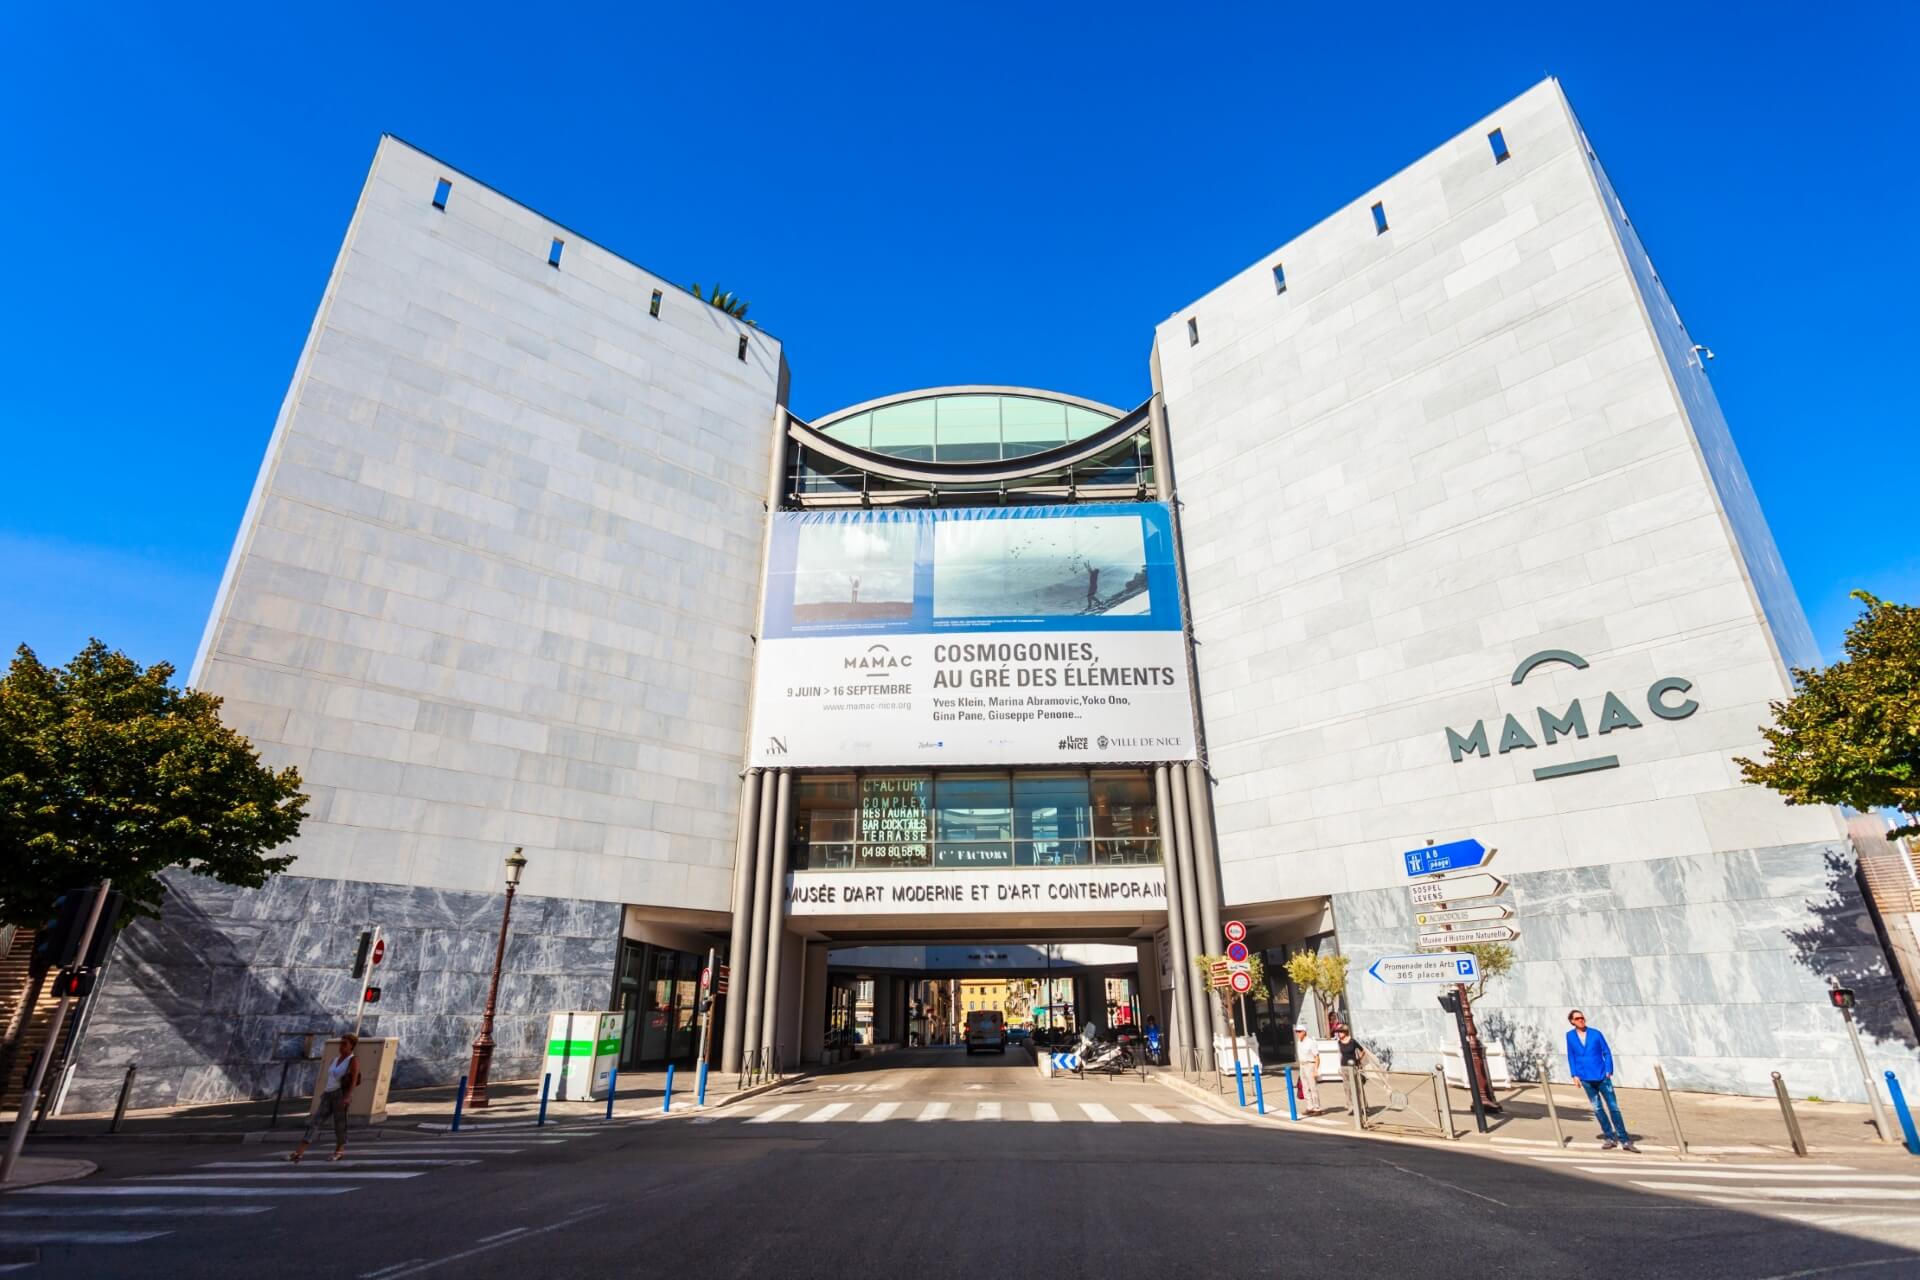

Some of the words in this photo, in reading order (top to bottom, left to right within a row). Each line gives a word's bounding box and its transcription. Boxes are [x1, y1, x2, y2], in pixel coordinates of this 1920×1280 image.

[934, 643, 1099, 663] COSMOGONIES,
[844, 655, 912, 668] MAMAC
[933, 669, 962, 688] AU
[970, 664, 1011, 688] GRÉ
[1017, 668, 1057, 687] DES
[1064, 662, 1175, 687] ÉLÉMENTS
[787, 688, 793, 697] 9
[795, 686, 821, 697] JUIN
[834, 686, 844, 696] 16
[846, 684, 912, 696] SEPTEMBRE
[823, 701, 912, 712] www.mamac-nice.org
[933, 698, 956, 707] Yves
[958, 697, 986, 708] Klein,
[989, 697, 1024, 706] Marina
[1108, 695, 1131, 706] Ono,
[933, 711, 955, 721] Gina
[958, 711, 986, 721] Pane,
[988, 710, 1034, 722] Giuseppe
[1037, 710, 1082, 720] Penone...
[1445, 677, 1699, 762] MAMAC
[1111, 738, 1137, 747] VILLE
[1140, 738, 1156, 747] DE
[1156, 737, 1182, 746] NICE
[863, 797, 926, 808] COMPLEX
[862, 808, 926, 818] RESTAURANT
[862, 819, 879, 830] BAR
[882, 819, 927, 830] COCKTAILS
[862, 831, 926, 841] TERRASSE
[862, 847, 873, 857] 04
[875, 847, 886, 857] 93
[843, 886, 885, 902] D'ART
[892, 885, 963, 901] MODERNE
[971, 884, 989, 901] ET
[997, 883, 1040, 900] D'ART
[1048, 881, 1167, 899] CONTEMPORAIN
[1413, 885, 1442, 894] SOSPEL
[1414, 893, 1443, 903] LEVENS
[1476, 930, 1506, 939] Naturelle
[1384, 961, 1422, 971] Promenade
[1424, 961, 1437, 969] des
[1439, 960, 1454, 968] Arts
[1417, 971, 1445, 981] places
